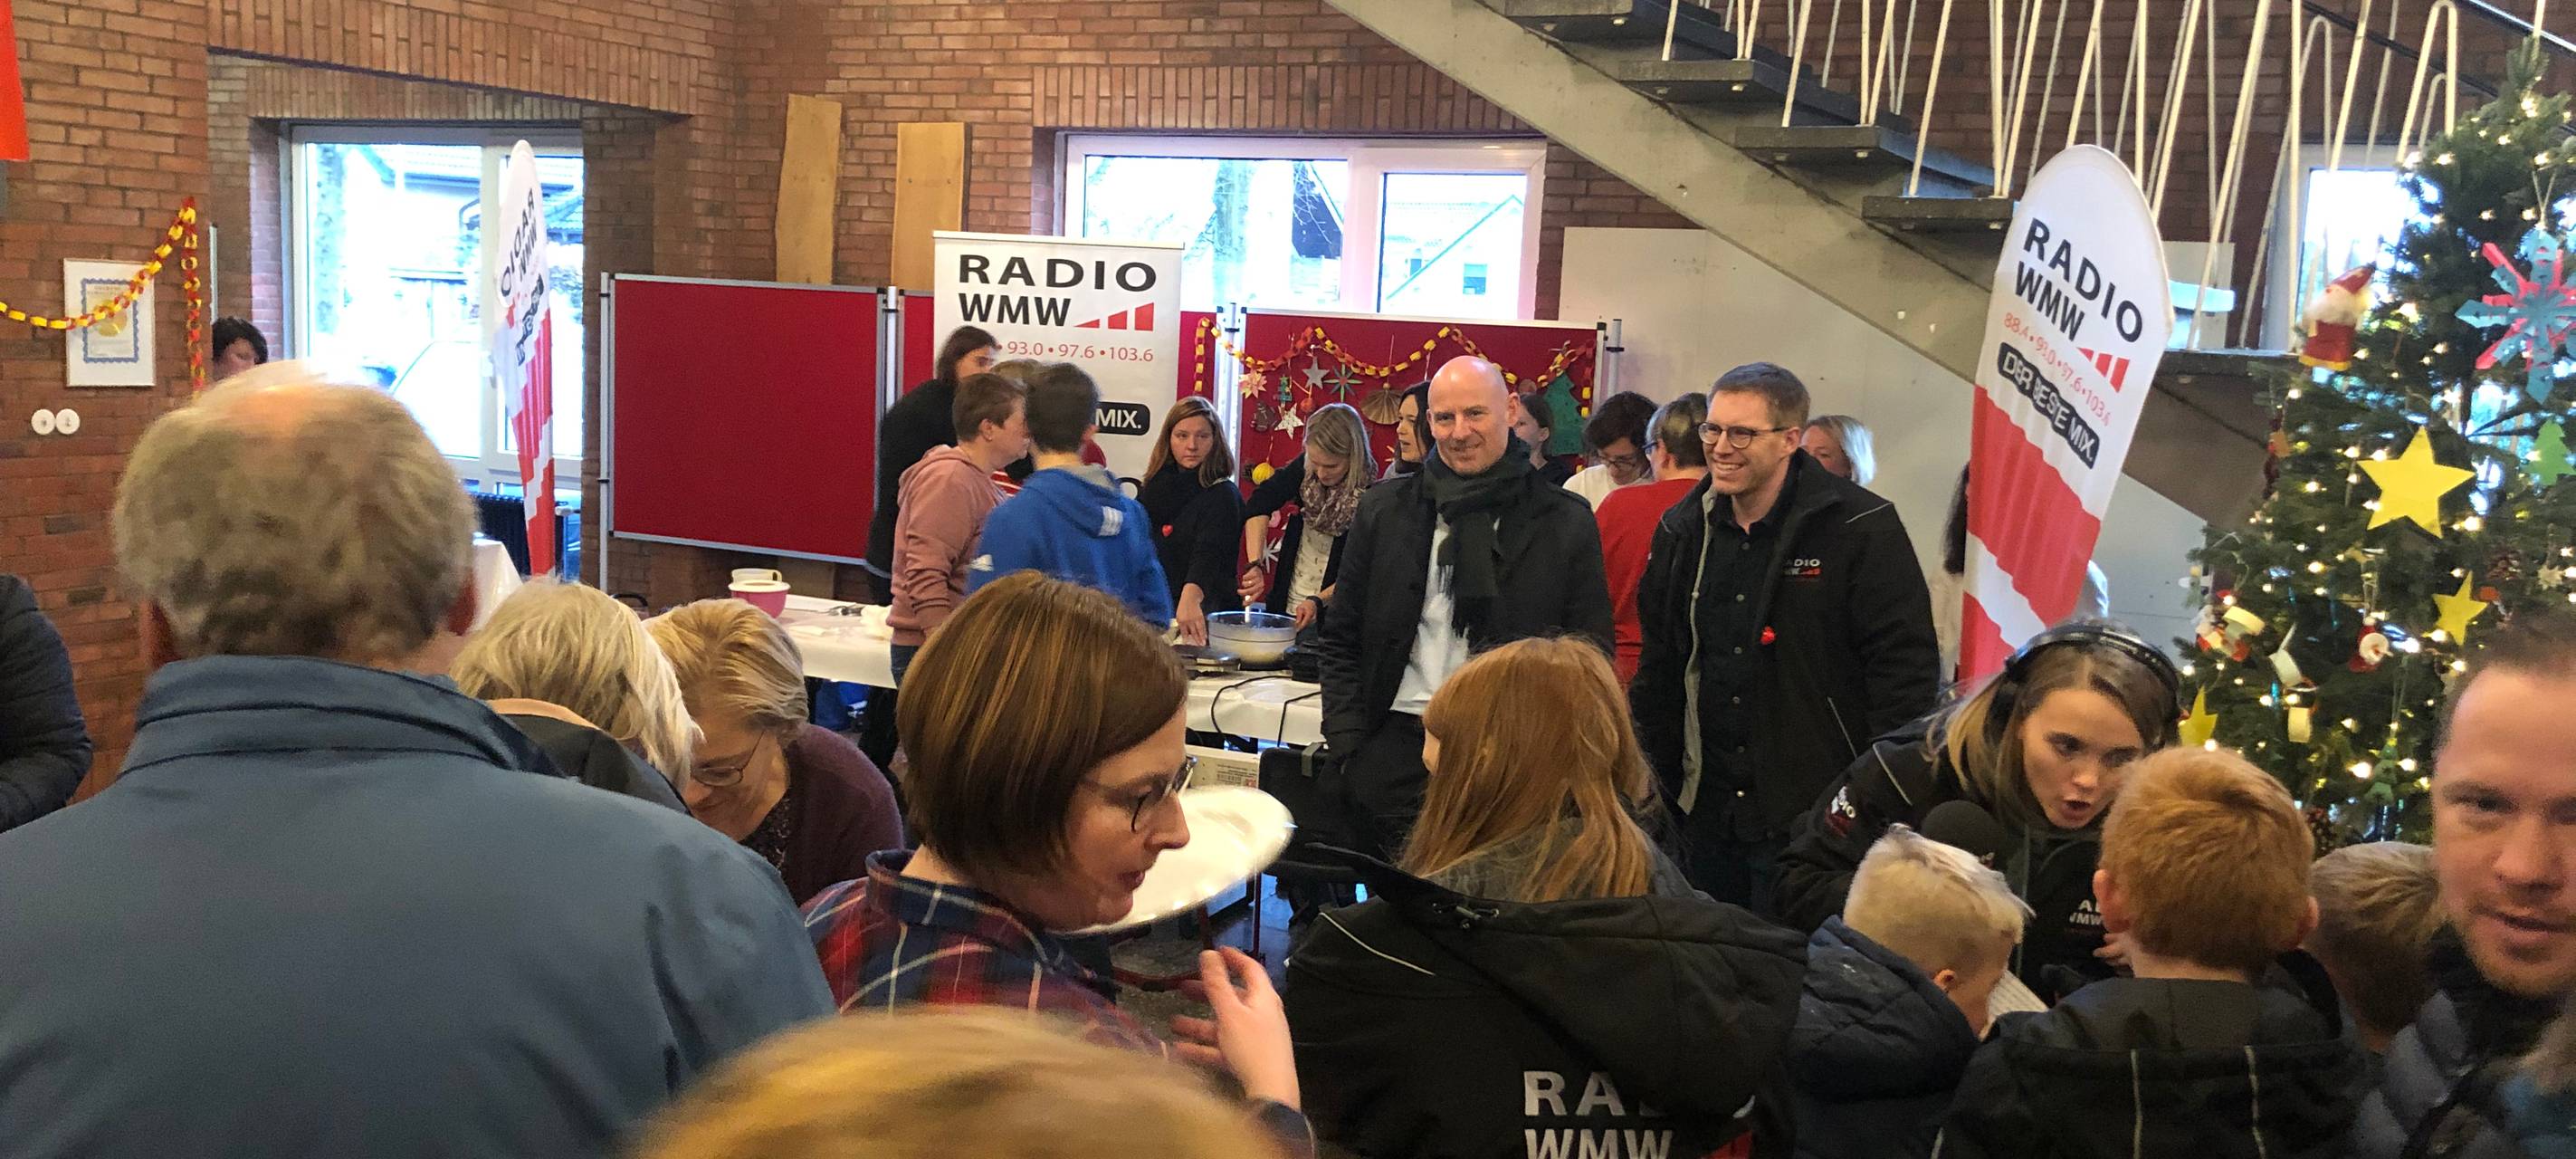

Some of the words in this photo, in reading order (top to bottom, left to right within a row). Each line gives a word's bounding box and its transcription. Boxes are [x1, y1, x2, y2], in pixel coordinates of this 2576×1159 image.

[959, 254, 1157, 292] RADIO
[2023, 217, 2142, 342] RADIO
[958, 292, 1072, 327] WMW
[2016, 261, 2085, 341] WMW
[1007, 340, 1044, 356] 93.0
[1058, 343, 1095, 359] 97.6
[1109, 346, 1154, 362] 103.6
[2003, 351, 2033, 390] DER
[1095, 407, 1142, 429] MIX.
[1524, 1128, 1674, 1159] WMW
